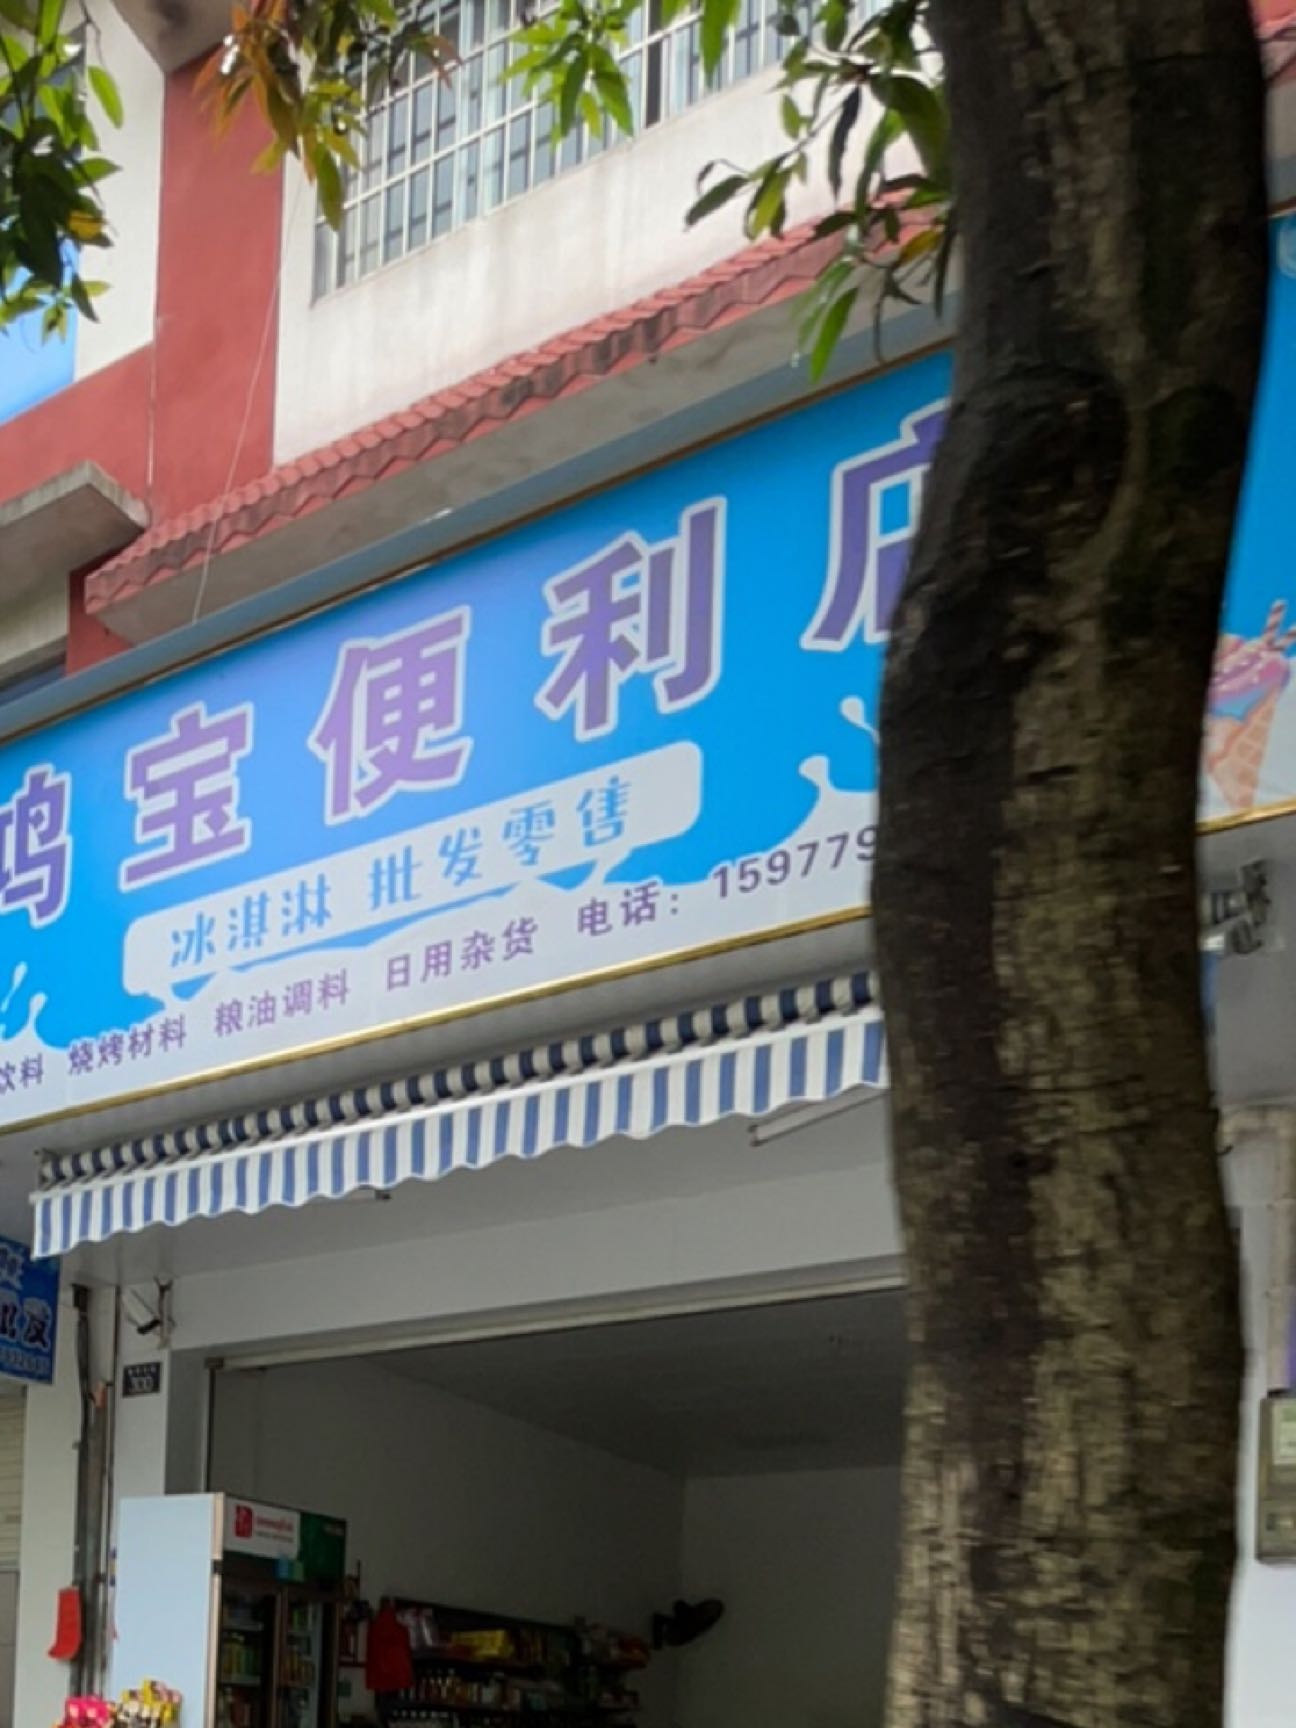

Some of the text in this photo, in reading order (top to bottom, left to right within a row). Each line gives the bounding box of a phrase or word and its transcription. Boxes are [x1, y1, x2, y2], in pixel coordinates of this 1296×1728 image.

[170, 775, 632, 968] 冰淇淋 批发零售
[67, 1014, 188, 1075] 烧烤材料
[213, 968, 352, 1038] 粮油调料
[385, 917, 540, 992] 日用杂货
